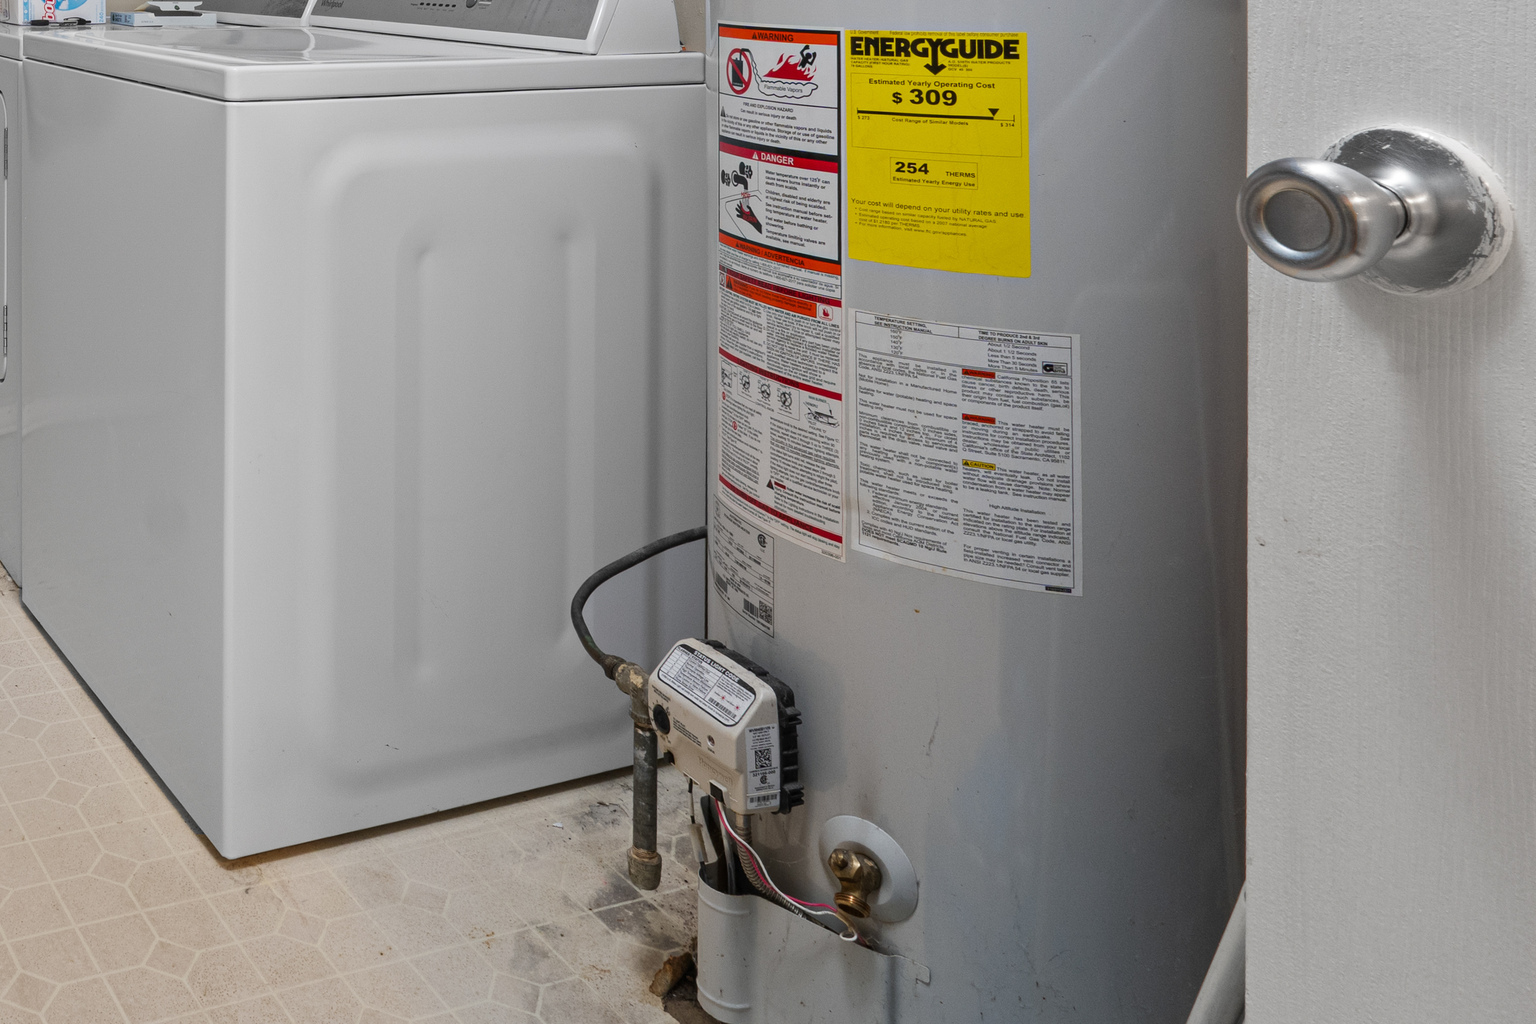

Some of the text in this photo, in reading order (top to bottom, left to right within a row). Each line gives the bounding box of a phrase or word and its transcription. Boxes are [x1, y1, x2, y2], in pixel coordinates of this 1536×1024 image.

[758, 32, 793, 42] WARNING
[850, 36, 1020, 60] ENERGYGUIDE
[764, 84, 786, 92] Flammable
[908, 80, 932, 88] Yearly
[934, 81, 973, 89] Operating
[892, 88, 958, 106] $ 309
[761, 153, 794, 165] DANGER
[895, 161, 929, 175] 254
[776, 171, 798, 179] temperature
[802, 181, 820, 189] instantly
[808, 196, 822, 204] elderly
[895, 202, 921, 211] depend
[952, 207, 971, 216] utility
[797, 222, 813, 230] bathing
[764, 249, 805, 266] ADVERTENCIA
[874, 316, 905, 325] TEMPERATURE
[884, 322, 912, 331] INSTRUCTION
[694, 650, 740, 683] STATUS LIGHT CODE
